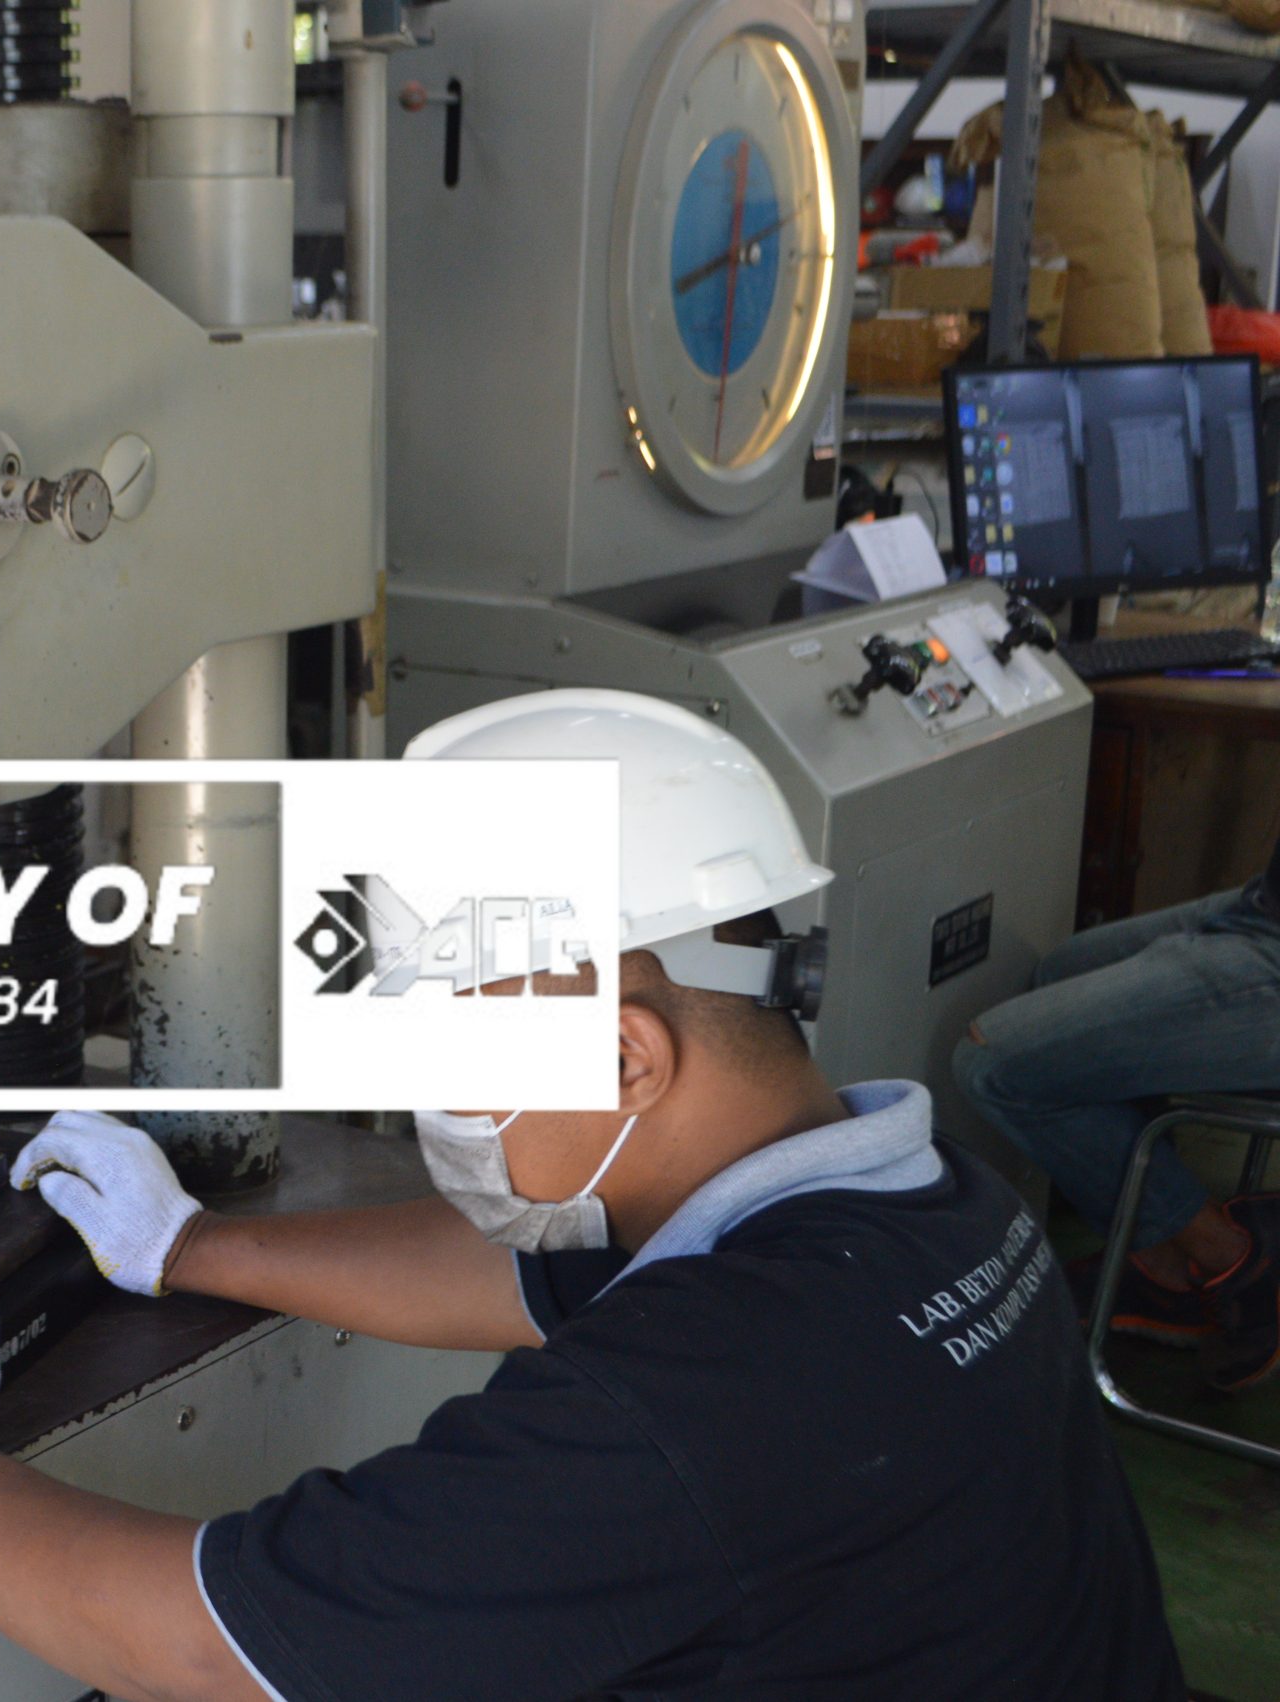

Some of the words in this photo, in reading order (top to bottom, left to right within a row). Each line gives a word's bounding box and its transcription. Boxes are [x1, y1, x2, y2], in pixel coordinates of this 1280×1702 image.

[897, 1291, 967, 1338] LAB.
[953, 1257, 1007, 1304] BETON
[941, 1318, 1000, 1367] DAN
